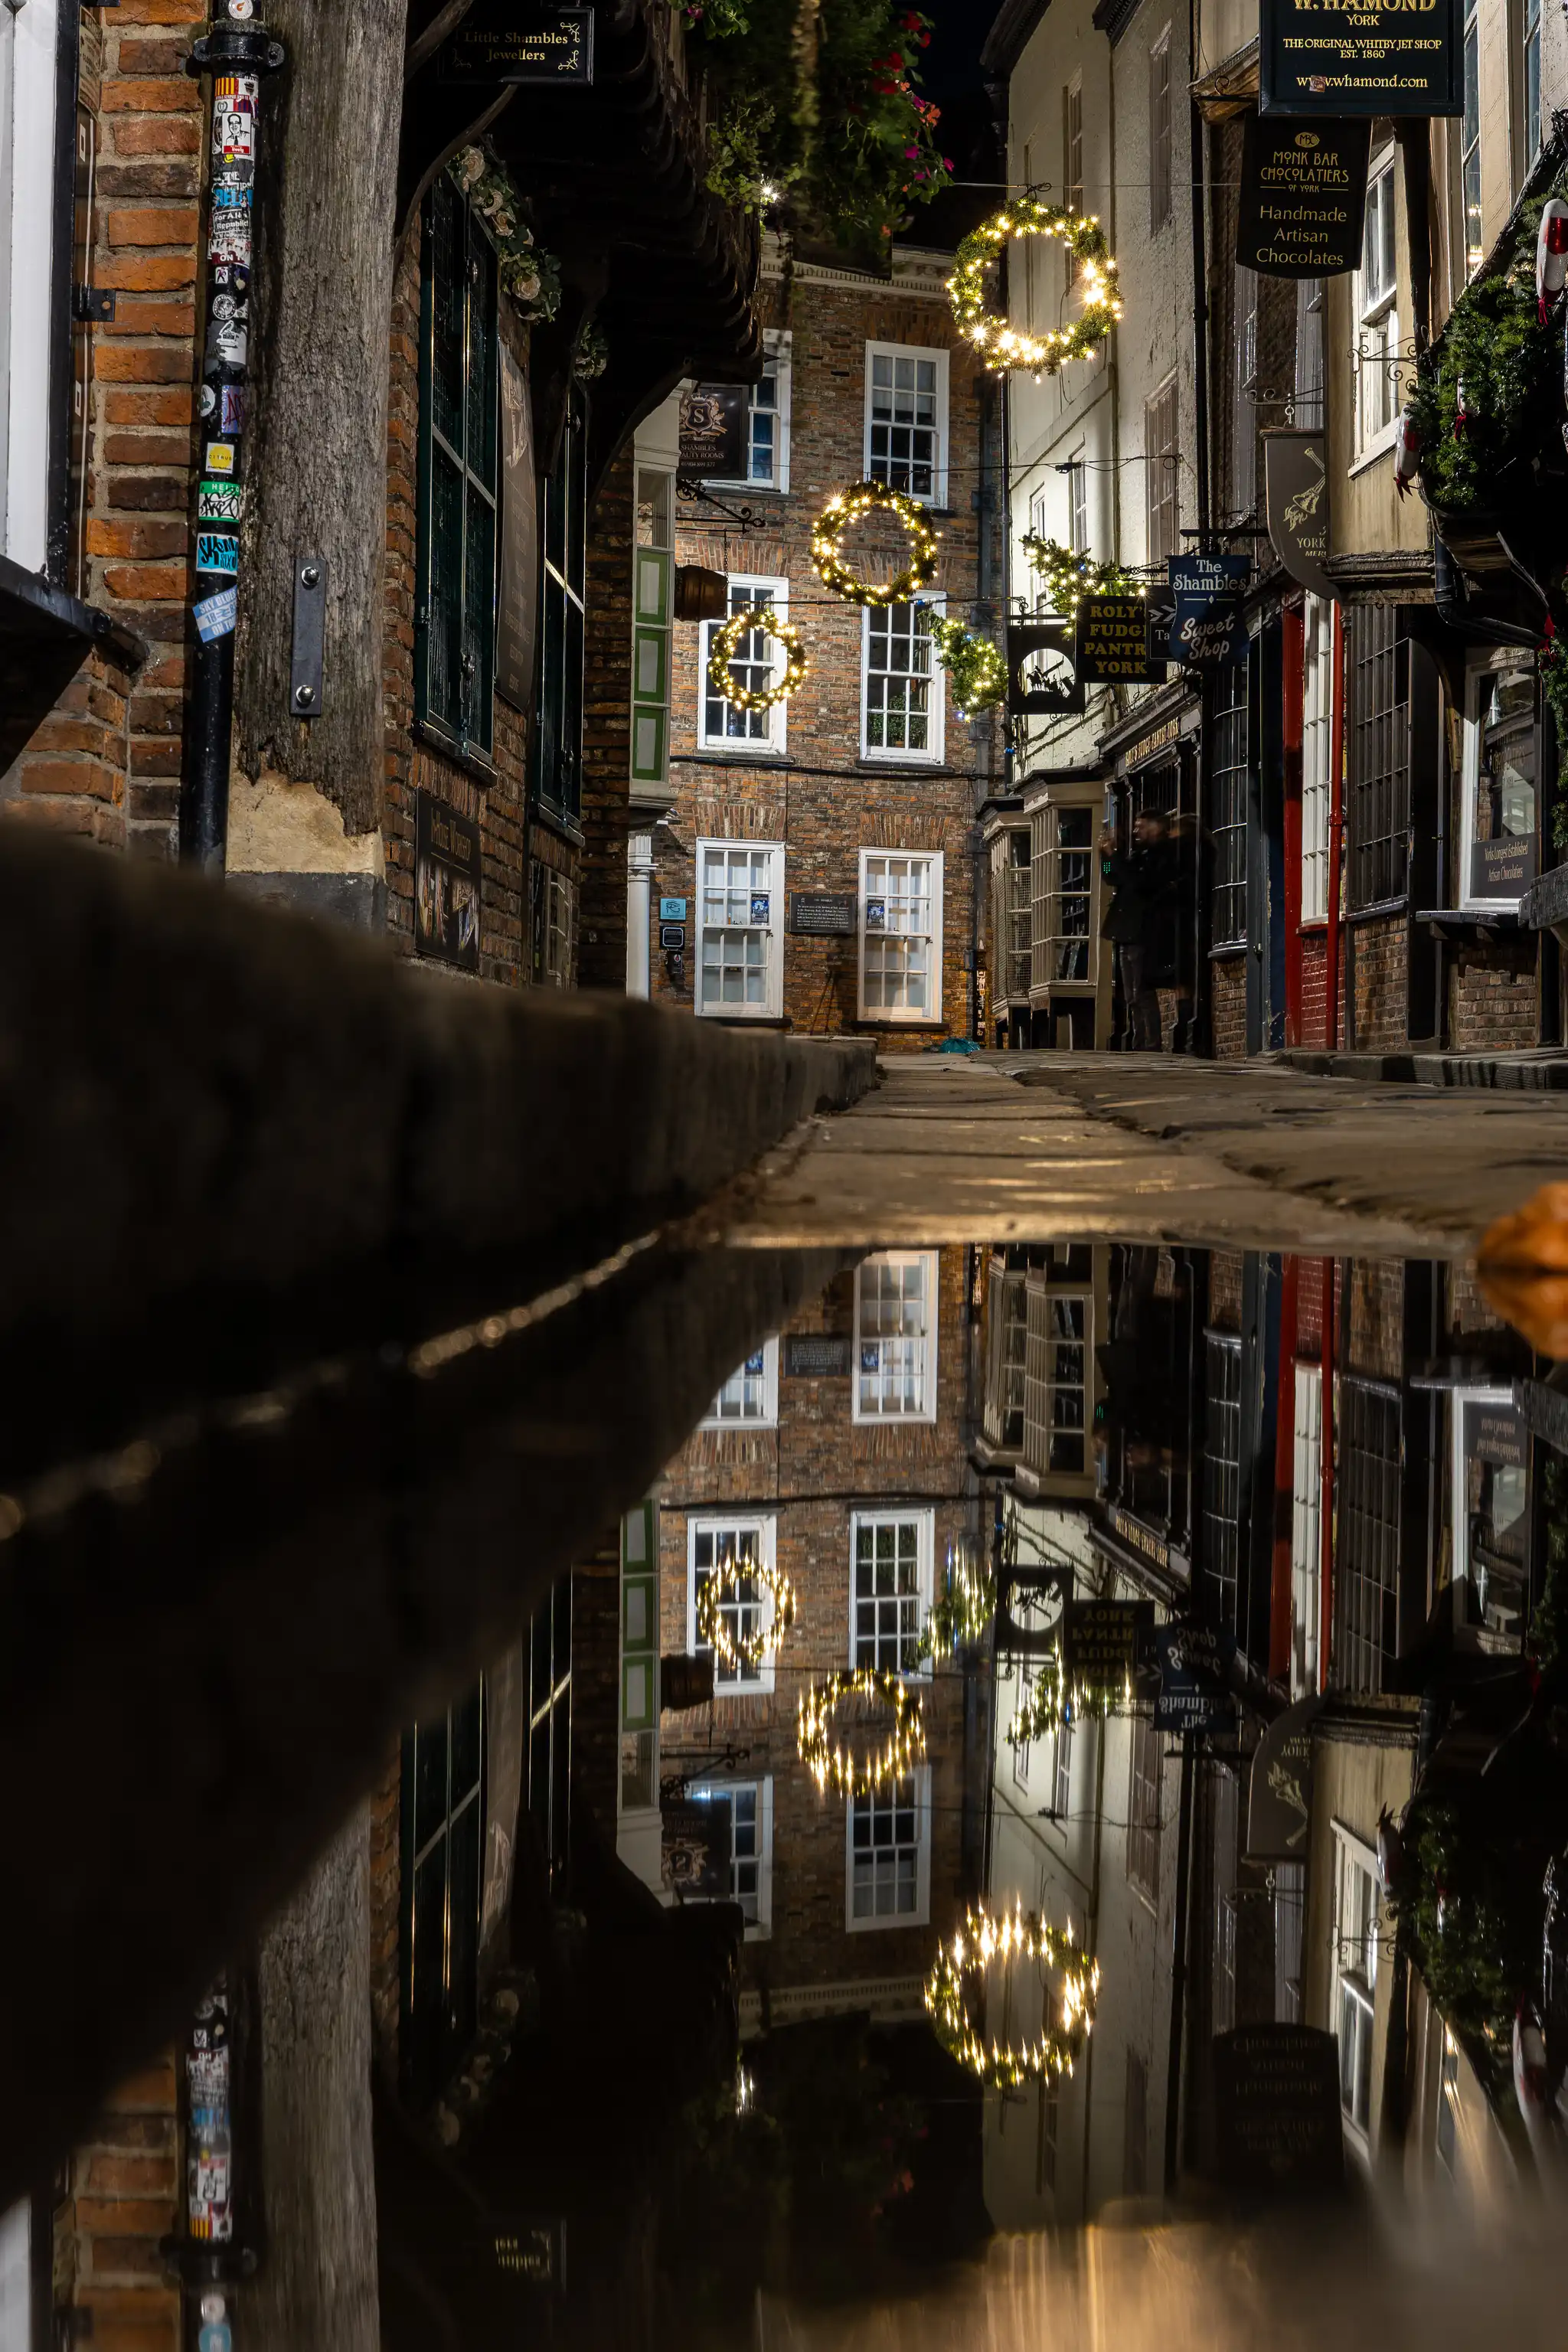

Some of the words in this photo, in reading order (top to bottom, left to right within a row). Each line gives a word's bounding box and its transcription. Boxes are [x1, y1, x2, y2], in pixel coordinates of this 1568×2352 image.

[1346, 14, 1380, 26] YORK
[463, 32, 499, 44] Little
[505, 32, 568, 44] Shambles
[1283, 38, 1303, 48] THE
[1305, 39, 1354, 48] ORIGINAL
[1355, 39, 1396, 48] WHITBY
[1396, 40, 1414, 51] JET
[1415, 40, 1442, 49] SHOP
[486, 48, 545, 63] Jewellers
[1340, 50, 1358, 58] EST.
[1363, 50, 1385, 58] 1860
[1273, 152, 1308, 165] MONK
[1314, 153, 1338, 166] BAR
[1260, 167, 1349, 182] CHOCOLATIERS
[1260, 205, 1347, 222] Handmade
[1274, 227, 1328, 243] Artisan
[1256, 248, 1344, 265] Chocolates
[694, 408, 704, 423] S
[1296, 537, 1326, 548] YORK
[1196, 560, 1222, 573] The
[1173, 573, 1247, 590] Shambles
[200, 598, 215, 614] SKY
[1089, 605, 1147, 619] ROLY'
[1180, 612, 1236, 641] Sweet
[1084, 642, 1147, 655] PANTR
[1189, 637, 1230, 662] Shop
[1095, 661, 1148, 674] YORK
[1508, 840, 1529, 858] Established
